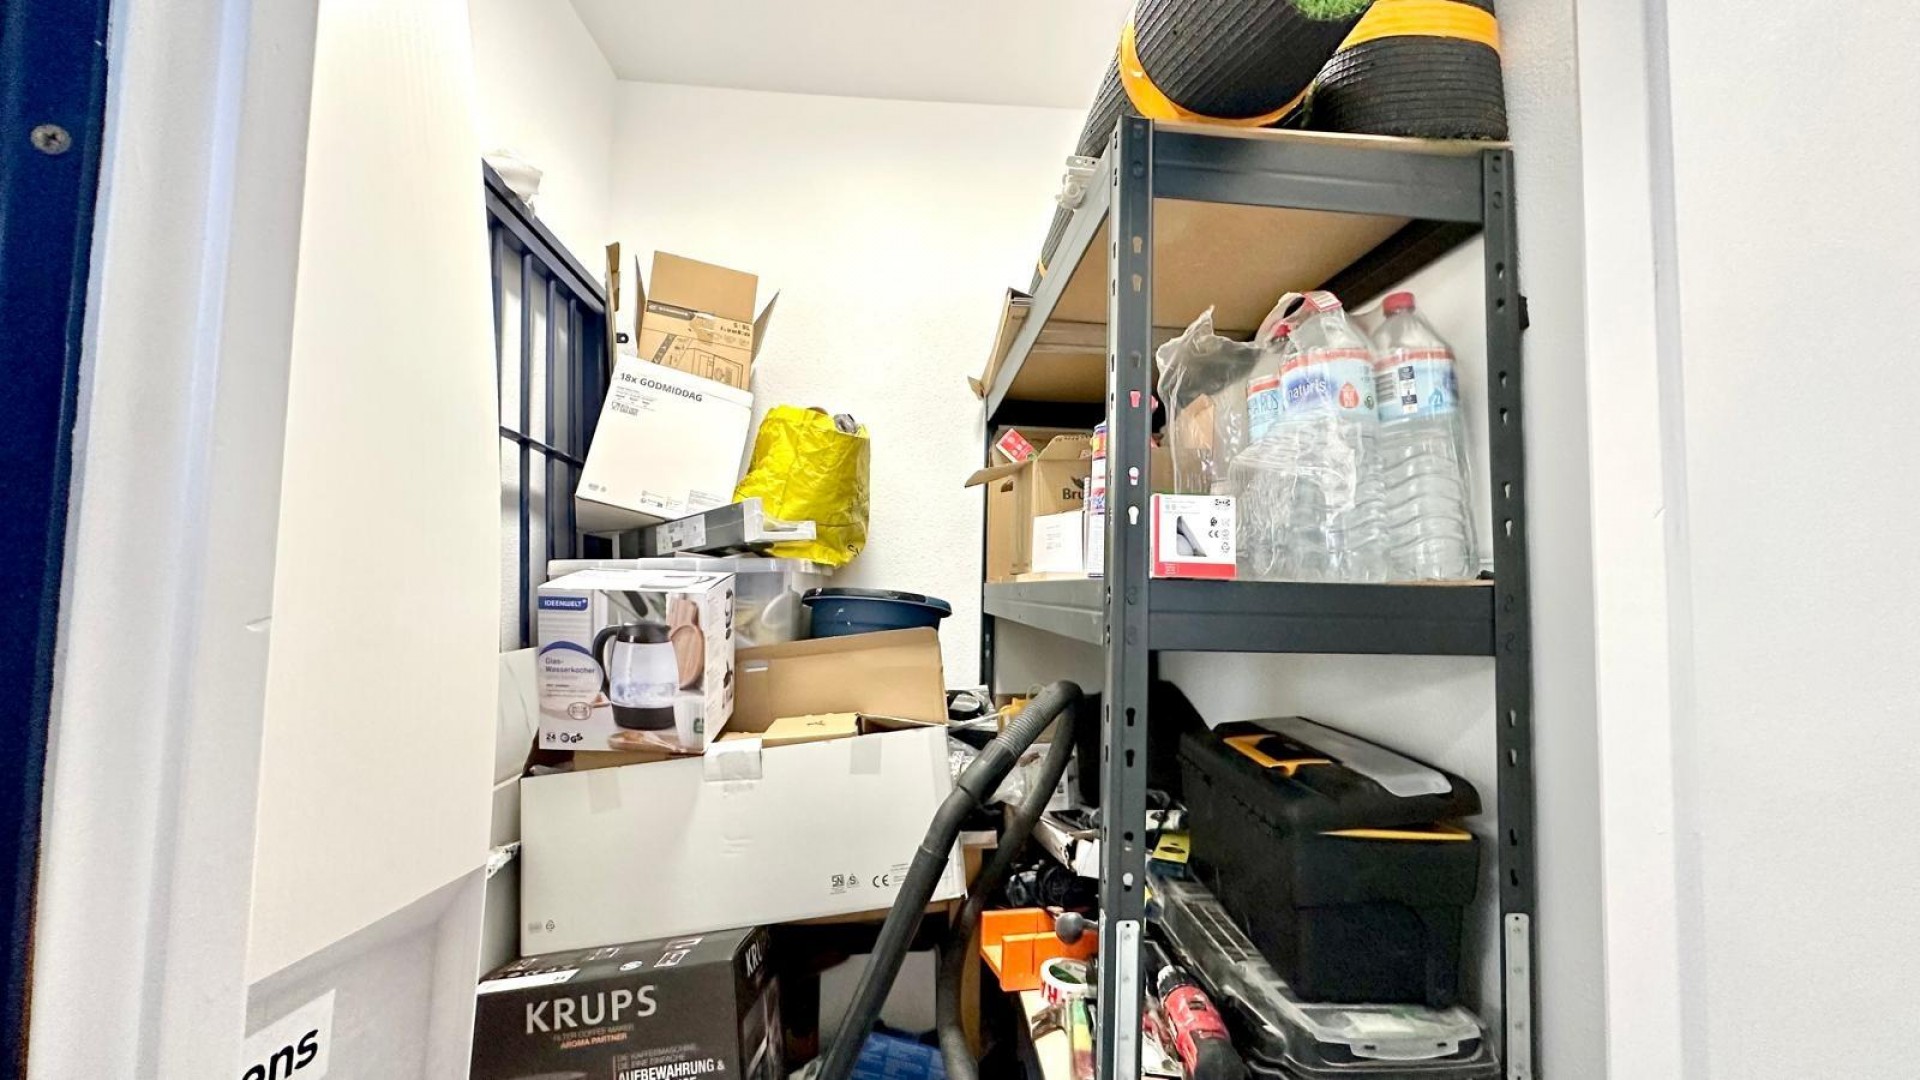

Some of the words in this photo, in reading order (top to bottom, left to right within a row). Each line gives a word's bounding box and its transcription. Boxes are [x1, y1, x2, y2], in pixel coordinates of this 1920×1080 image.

[619, 372, 637, 384] 18x
[639, 377, 703, 402] GODMIDDAG
[545, 666, 595, 674] Wasserkocher
[526, 984, 657, 1035] KRUPS
[560, 1037, 590, 1050] AROMA
[591, 1032, 628, 1045] PARTNER
[618, 1058, 714, 1080] AUFBEWAHRUNG
